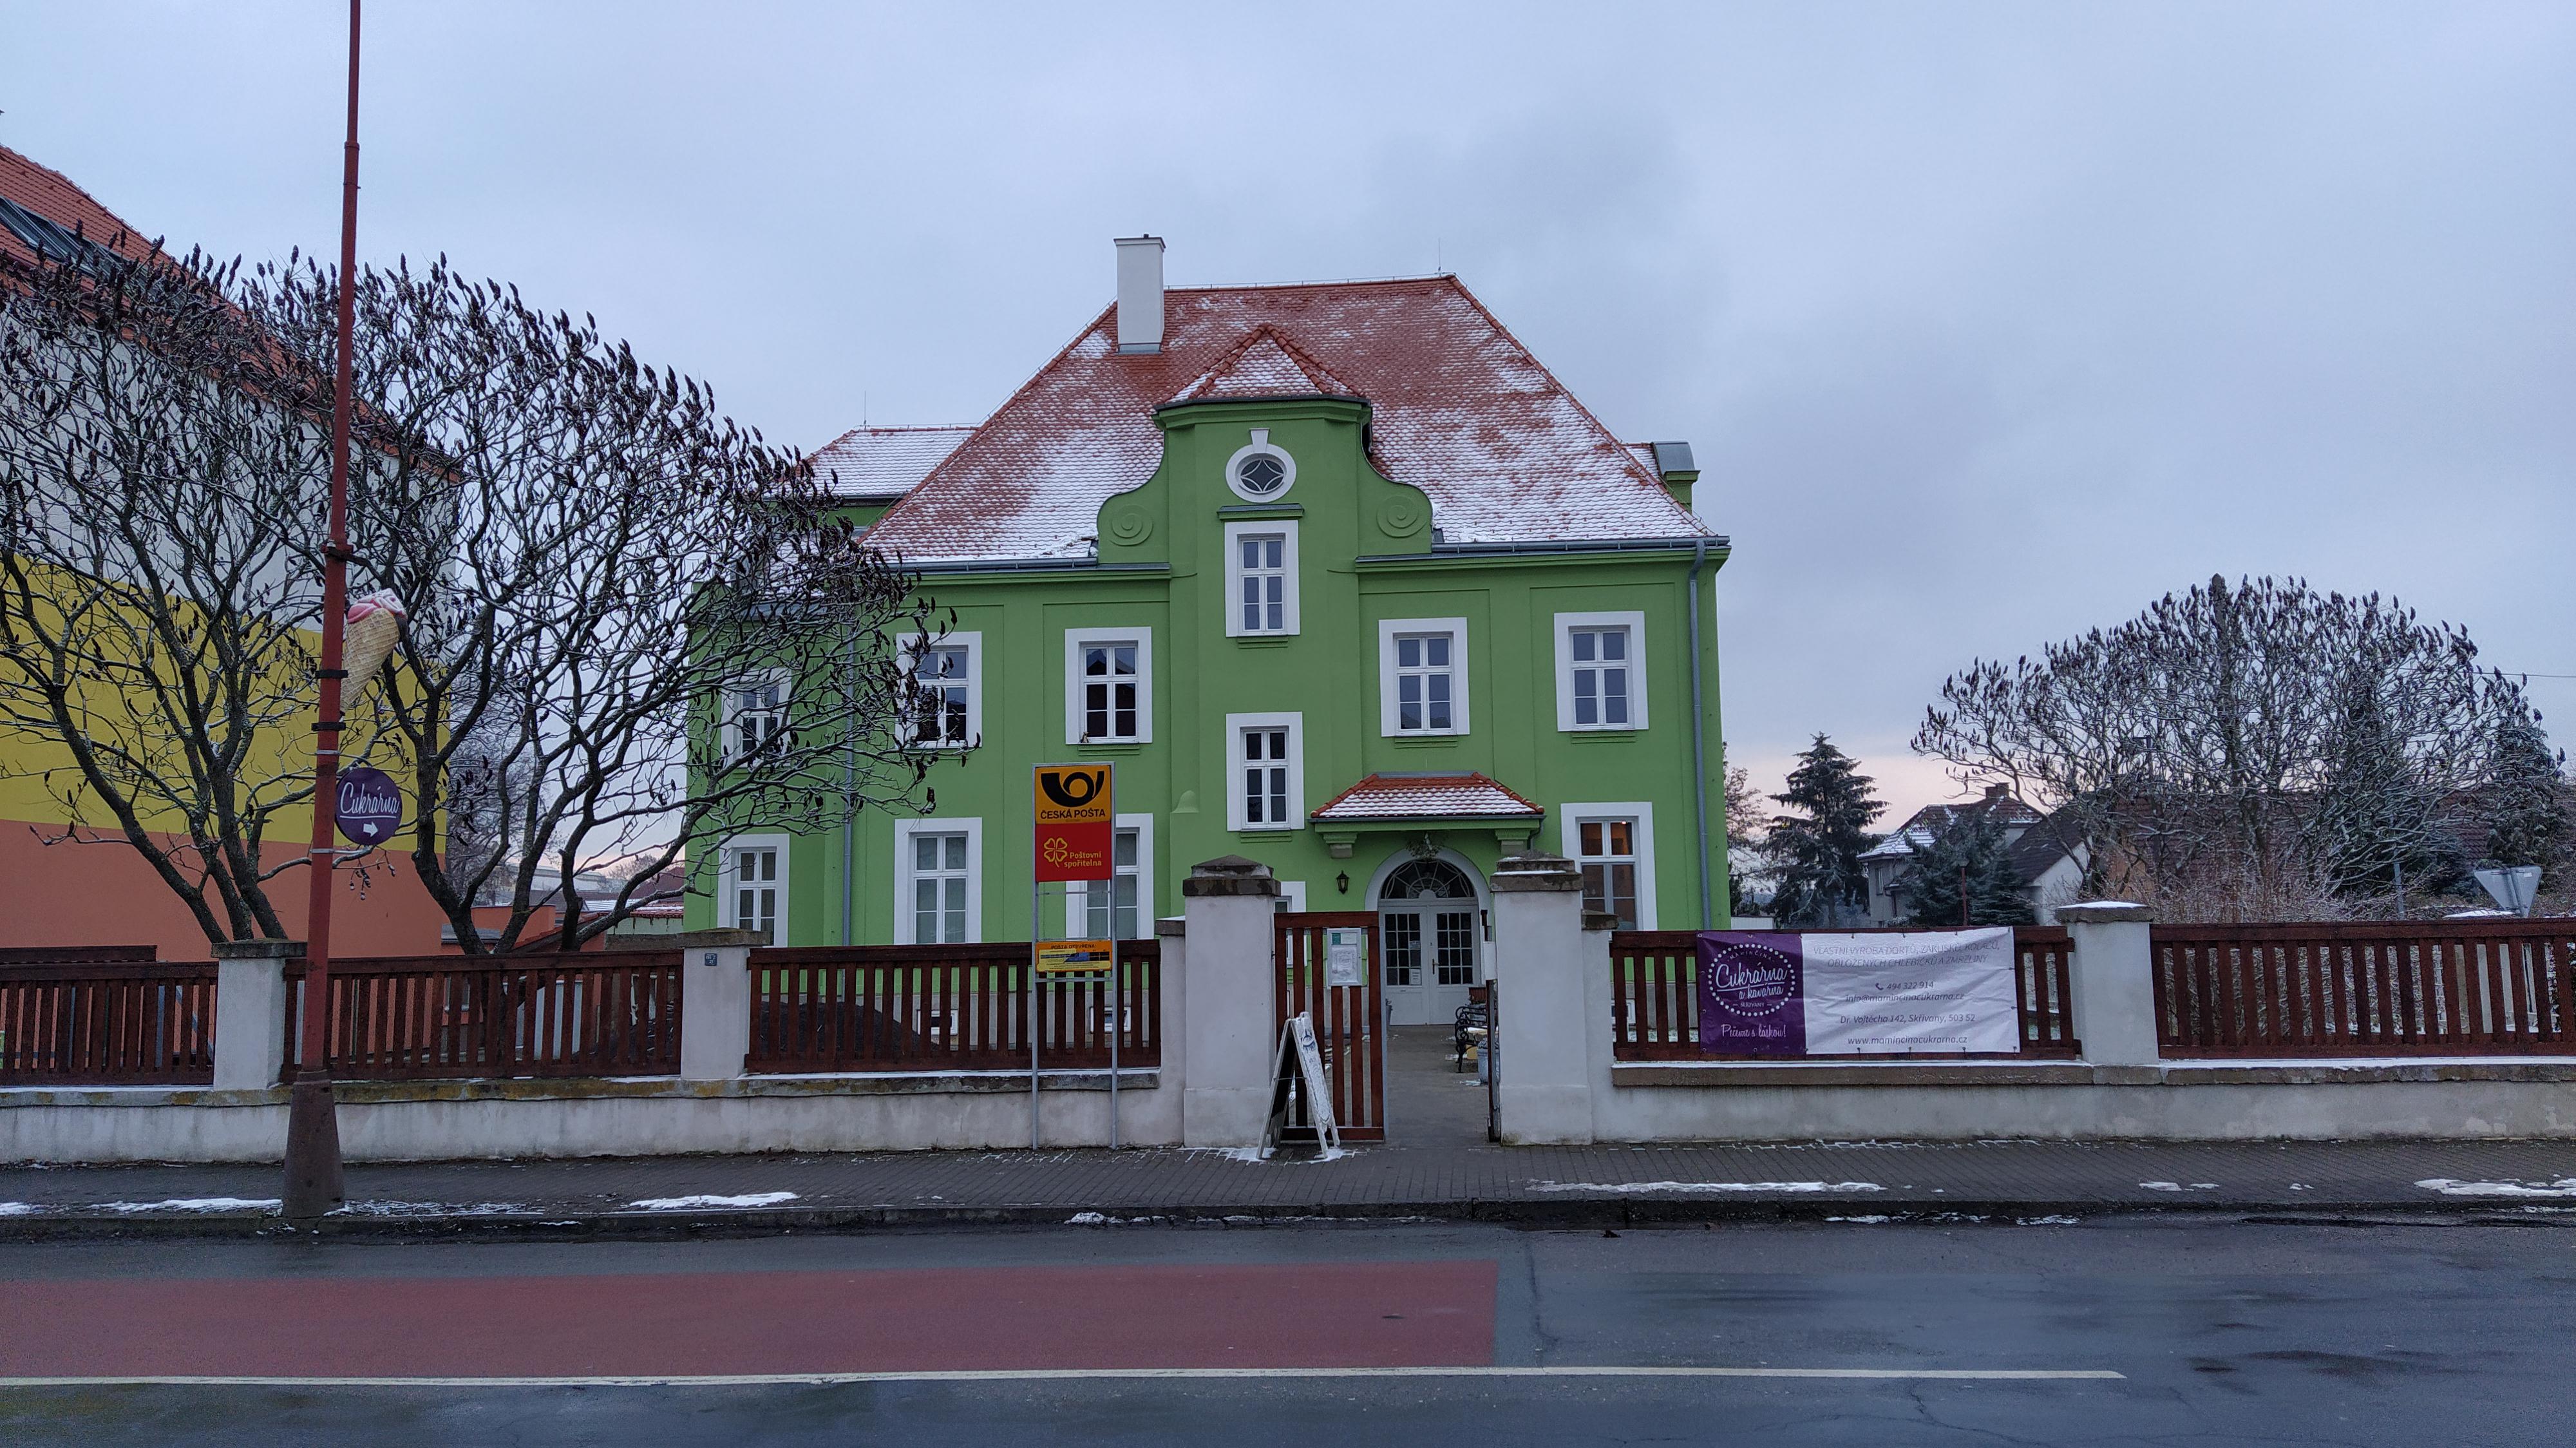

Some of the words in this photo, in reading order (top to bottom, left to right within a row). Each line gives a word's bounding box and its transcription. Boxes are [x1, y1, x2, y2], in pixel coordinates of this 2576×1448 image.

[340, 782, 400, 814] Cukrárna
[1040, 808, 1072, 819] ČESKÁ
[1074, 807, 1106, 818] POŠTA
[1070, 851, 1102, 859] Poštovní
[1064, 859, 1102, 869] spořitelna
[1716, 962, 1788, 988] Cukrárna
[1739, 991, 1746, 1000] a
[1747, 983, 1784, 999] kavárna
[1846, 993, 1964, 1003] info@mamincinacukrarna.cz
[1890, 1015, 1906, 1024] 142,
[1751, 1029, 1756, 1037] s
[1848, 1035, 1968, 1045] www.mamincinacukrarna.cz
